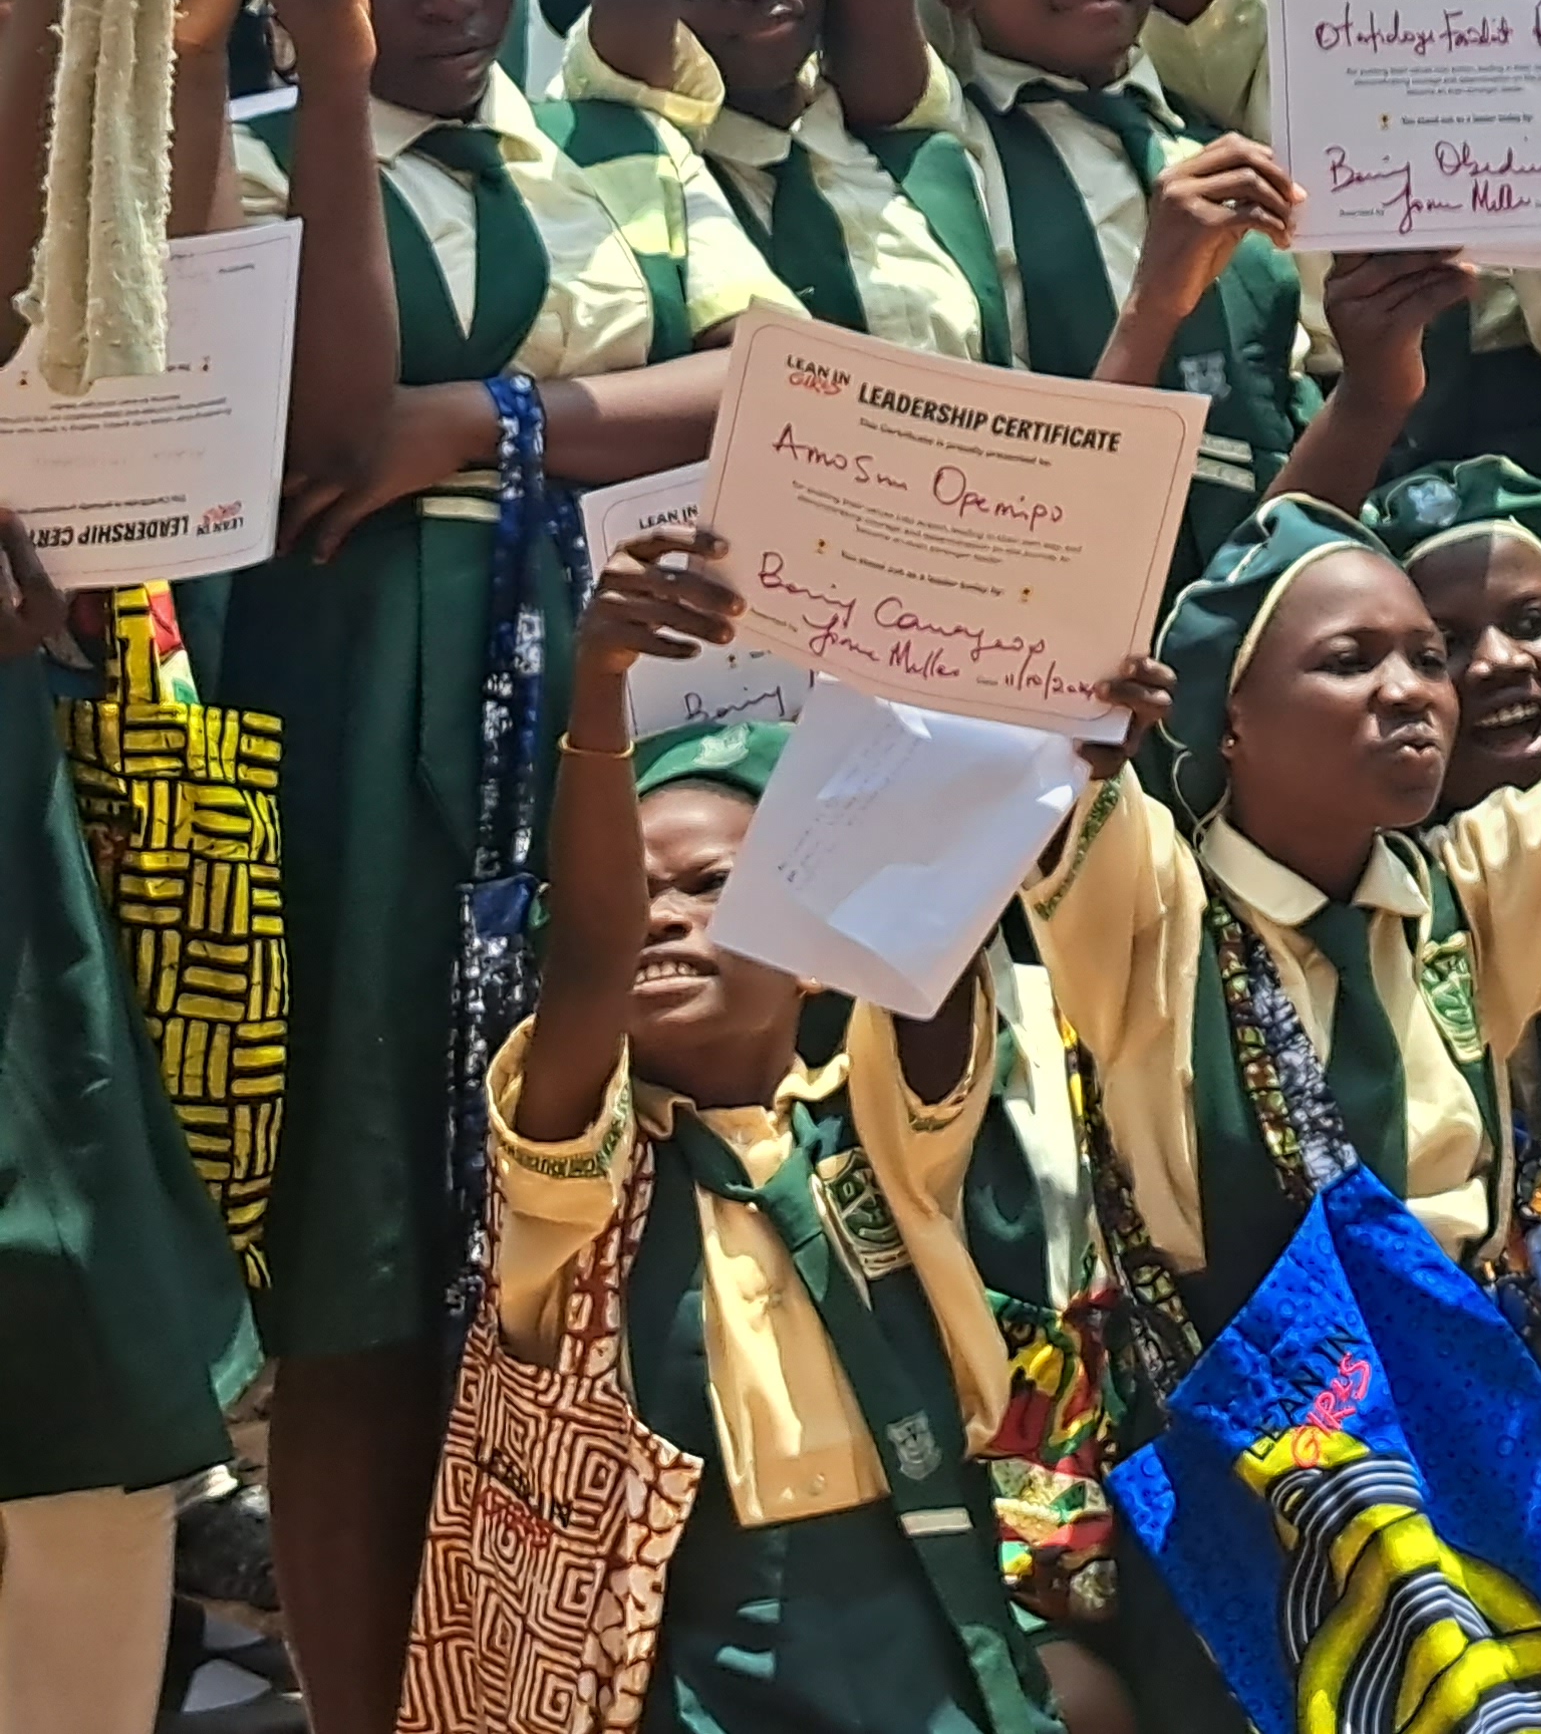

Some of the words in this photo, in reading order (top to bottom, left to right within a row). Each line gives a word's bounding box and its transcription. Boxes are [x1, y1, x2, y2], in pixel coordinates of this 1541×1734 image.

[787, 354, 829, 378] LEAN
[833, 369, 851, 385] IN
[858, 383, 988, 435] LEADERSHIP
[992, 414, 1122, 454] CERTIFICATE
[77, 514, 189, 546] LEADERSHIP
